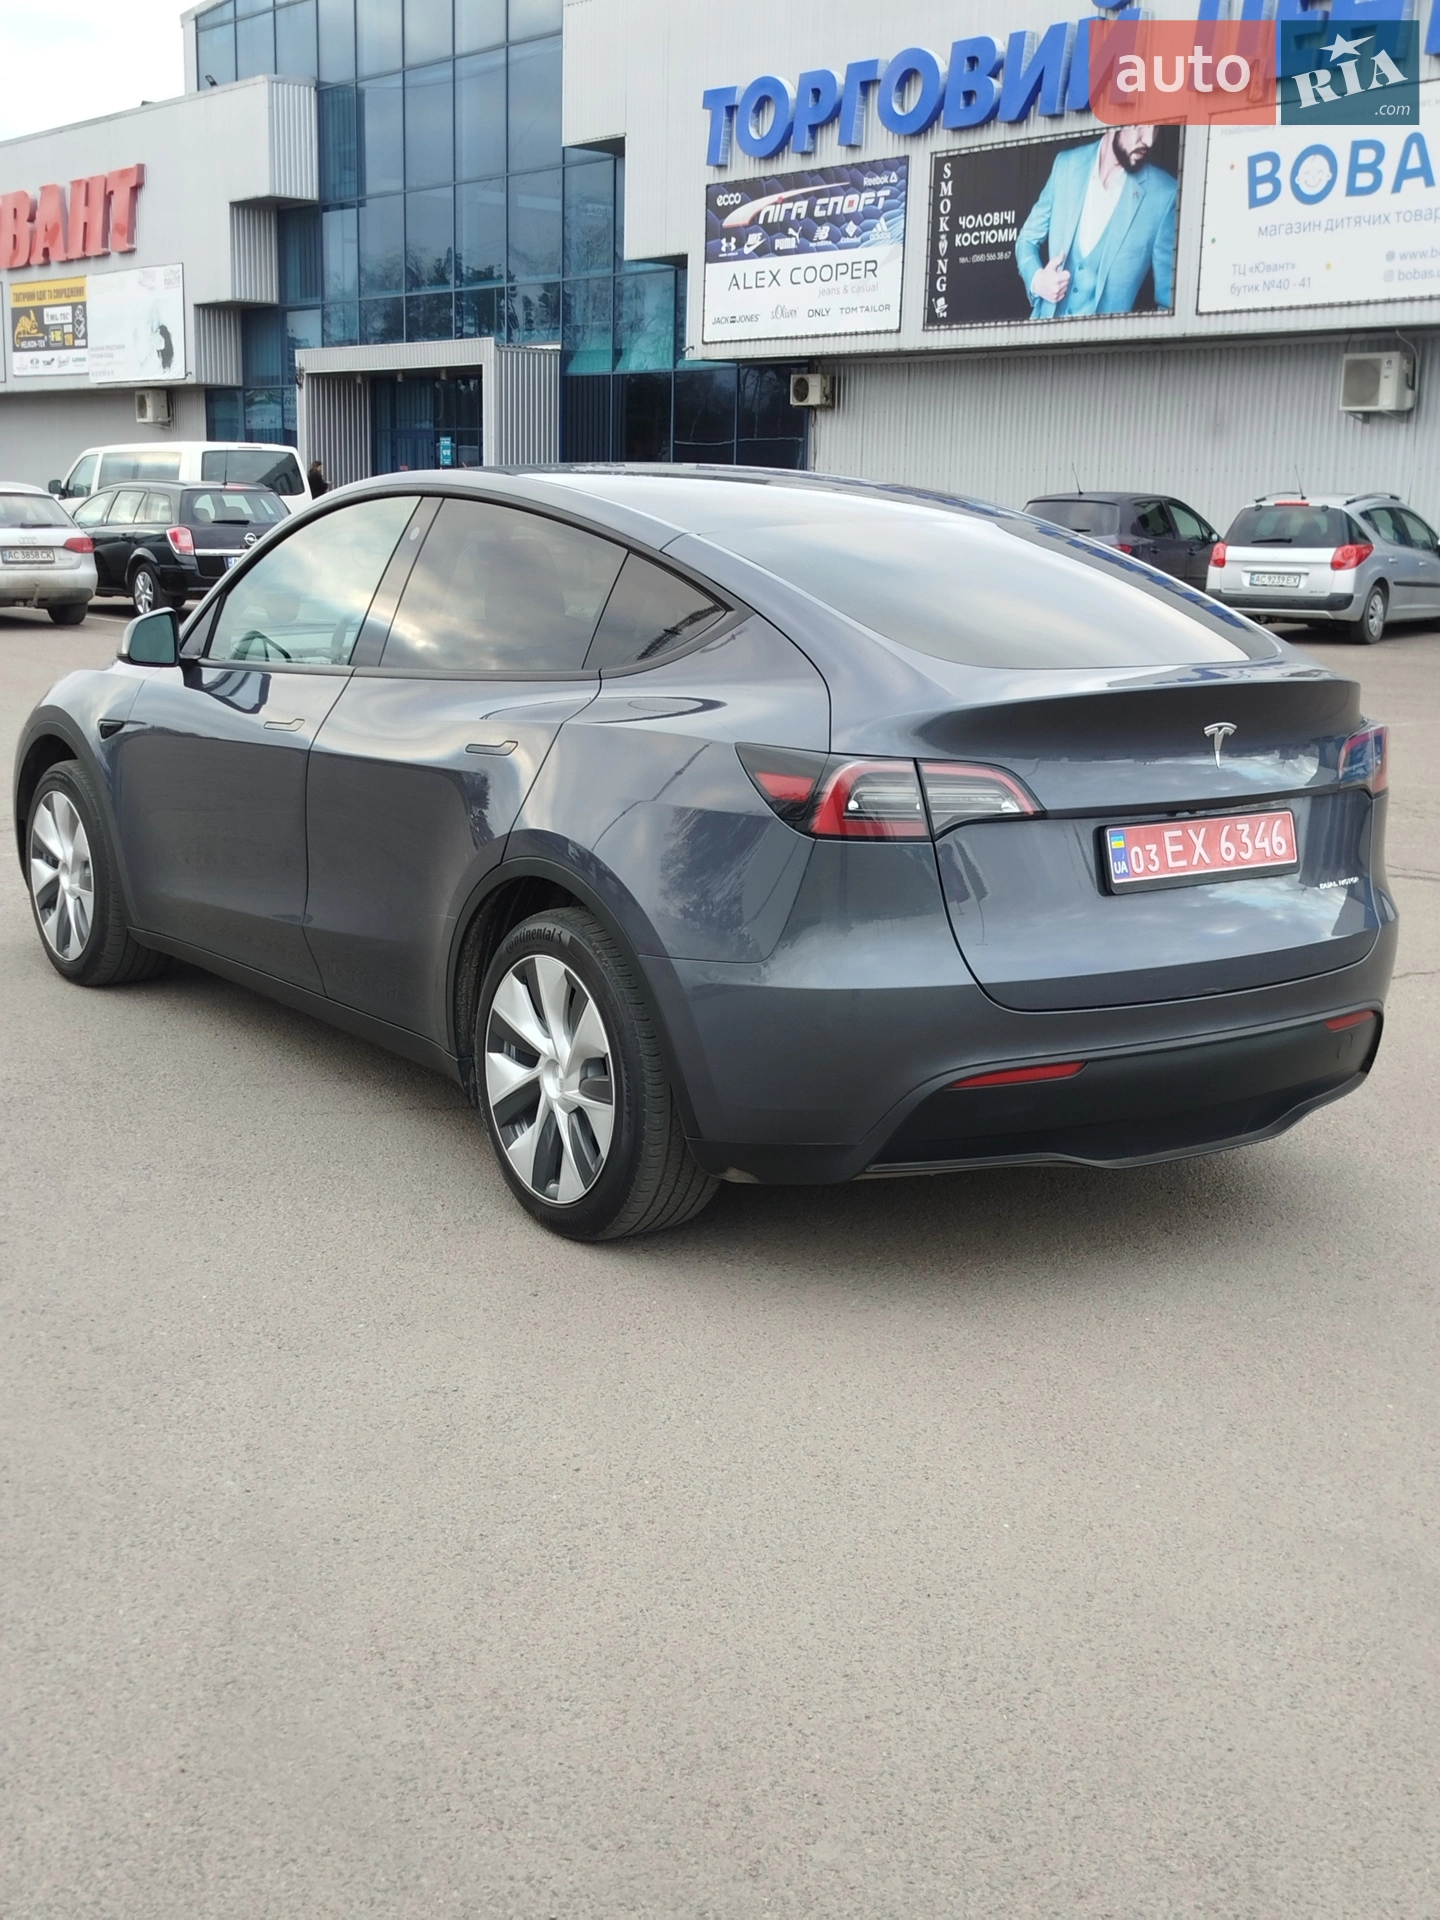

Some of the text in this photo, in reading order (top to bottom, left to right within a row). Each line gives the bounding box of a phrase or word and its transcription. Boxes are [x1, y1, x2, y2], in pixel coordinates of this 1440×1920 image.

[702, 0, 1150, 168] ТОРГОВИЙ
[863, 175, 889, 187] Reebok
[716, 192, 741, 207] ecco
[814, 189, 891, 218] СПОРТ
[958, 210, 1016, 229] ЧОЛОВІЧІ
[1257, 218, 1321, 238] магазин
[1324, 211, 1391, 233] дитячих
[955, 227, 1018, 247] КОСТЮМИ
[727, 259, 879, 292] ALEX COOPER
[1231, 263, 1246, 277] ТЦ
[818, 282, 879, 298] jeans & casual
[1229, 282, 1260, 297] бутик
[1262, 278, 1290, 292] №40
[807, 307, 831, 319] ONLY
[859, 304, 891, 314] TAILOR
[8, 551, 20, 560] AC
[21, 551, 40, 560] 3858
[41, 551, 53, 560] CK
[1254, 575, 1266, 585] AC
[1218, 818, 1288, 862] 6346
[1113, 860, 1128, 875] UA
[506, 926, 557, 953] Continental
